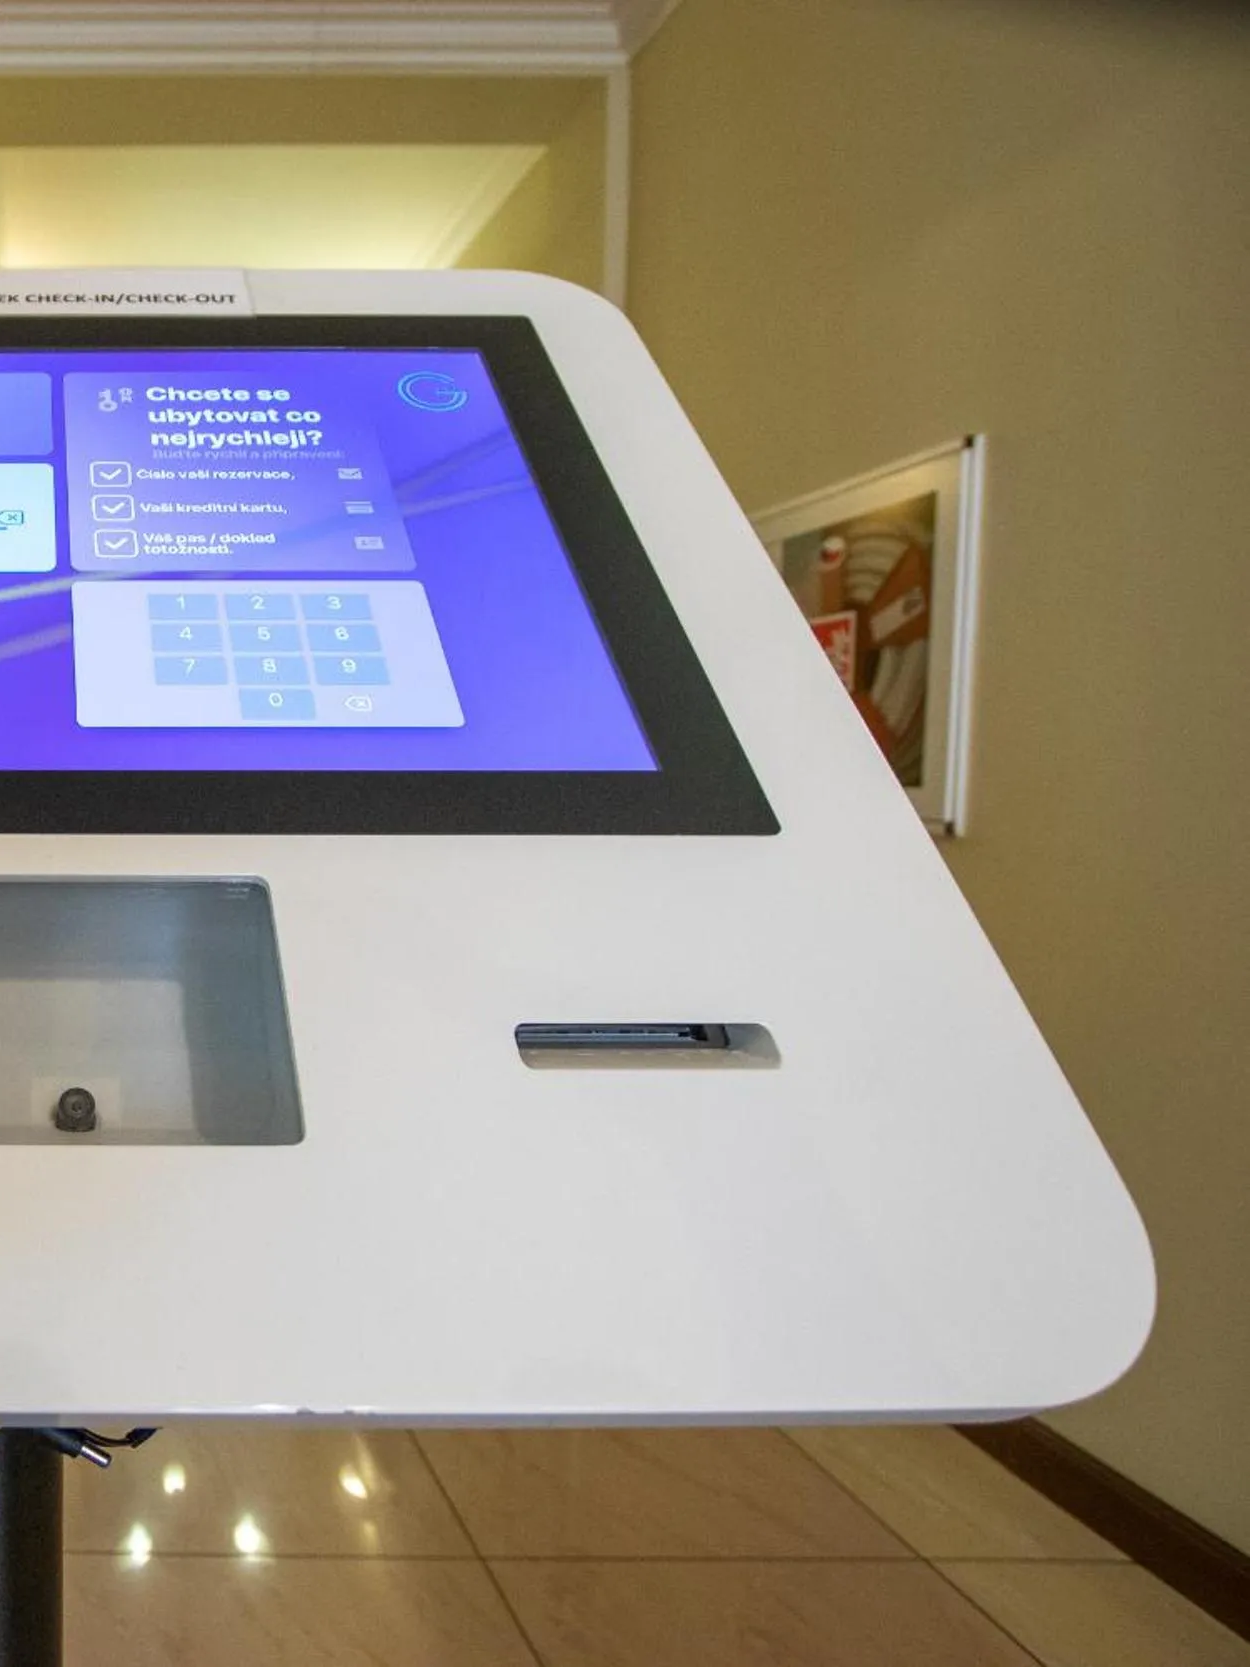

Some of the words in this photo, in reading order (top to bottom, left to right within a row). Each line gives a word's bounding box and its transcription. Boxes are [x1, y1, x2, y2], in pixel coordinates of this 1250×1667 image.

[24, 293, 237, 305] CHECK-IN/CHECK-OUT
[146, 387, 250, 401] Chcete
[256, 389, 291, 401] se
[148, 408, 281, 426] ubytovat
[286, 410, 322, 423] co
[150, 430, 323, 449] nejrychleji?
[241, 502, 288, 515] kartu,
[176, 535, 206, 546] pas
[219, 533, 276, 544] doklad
[176, 595, 186, 610] 1
[251, 595, 265, 610] 2
[326, 595, 342, 610] 3
[179, 626, 193, 641] 4
[257, 626, 271, 641] 5
[334, 626, 350, 641] 6
[183, 658, 196, 675] 7
[262, 657, 277, 673] 8
[341, 658, 357, 673] 9
[268, 692, 284, 707] 0
